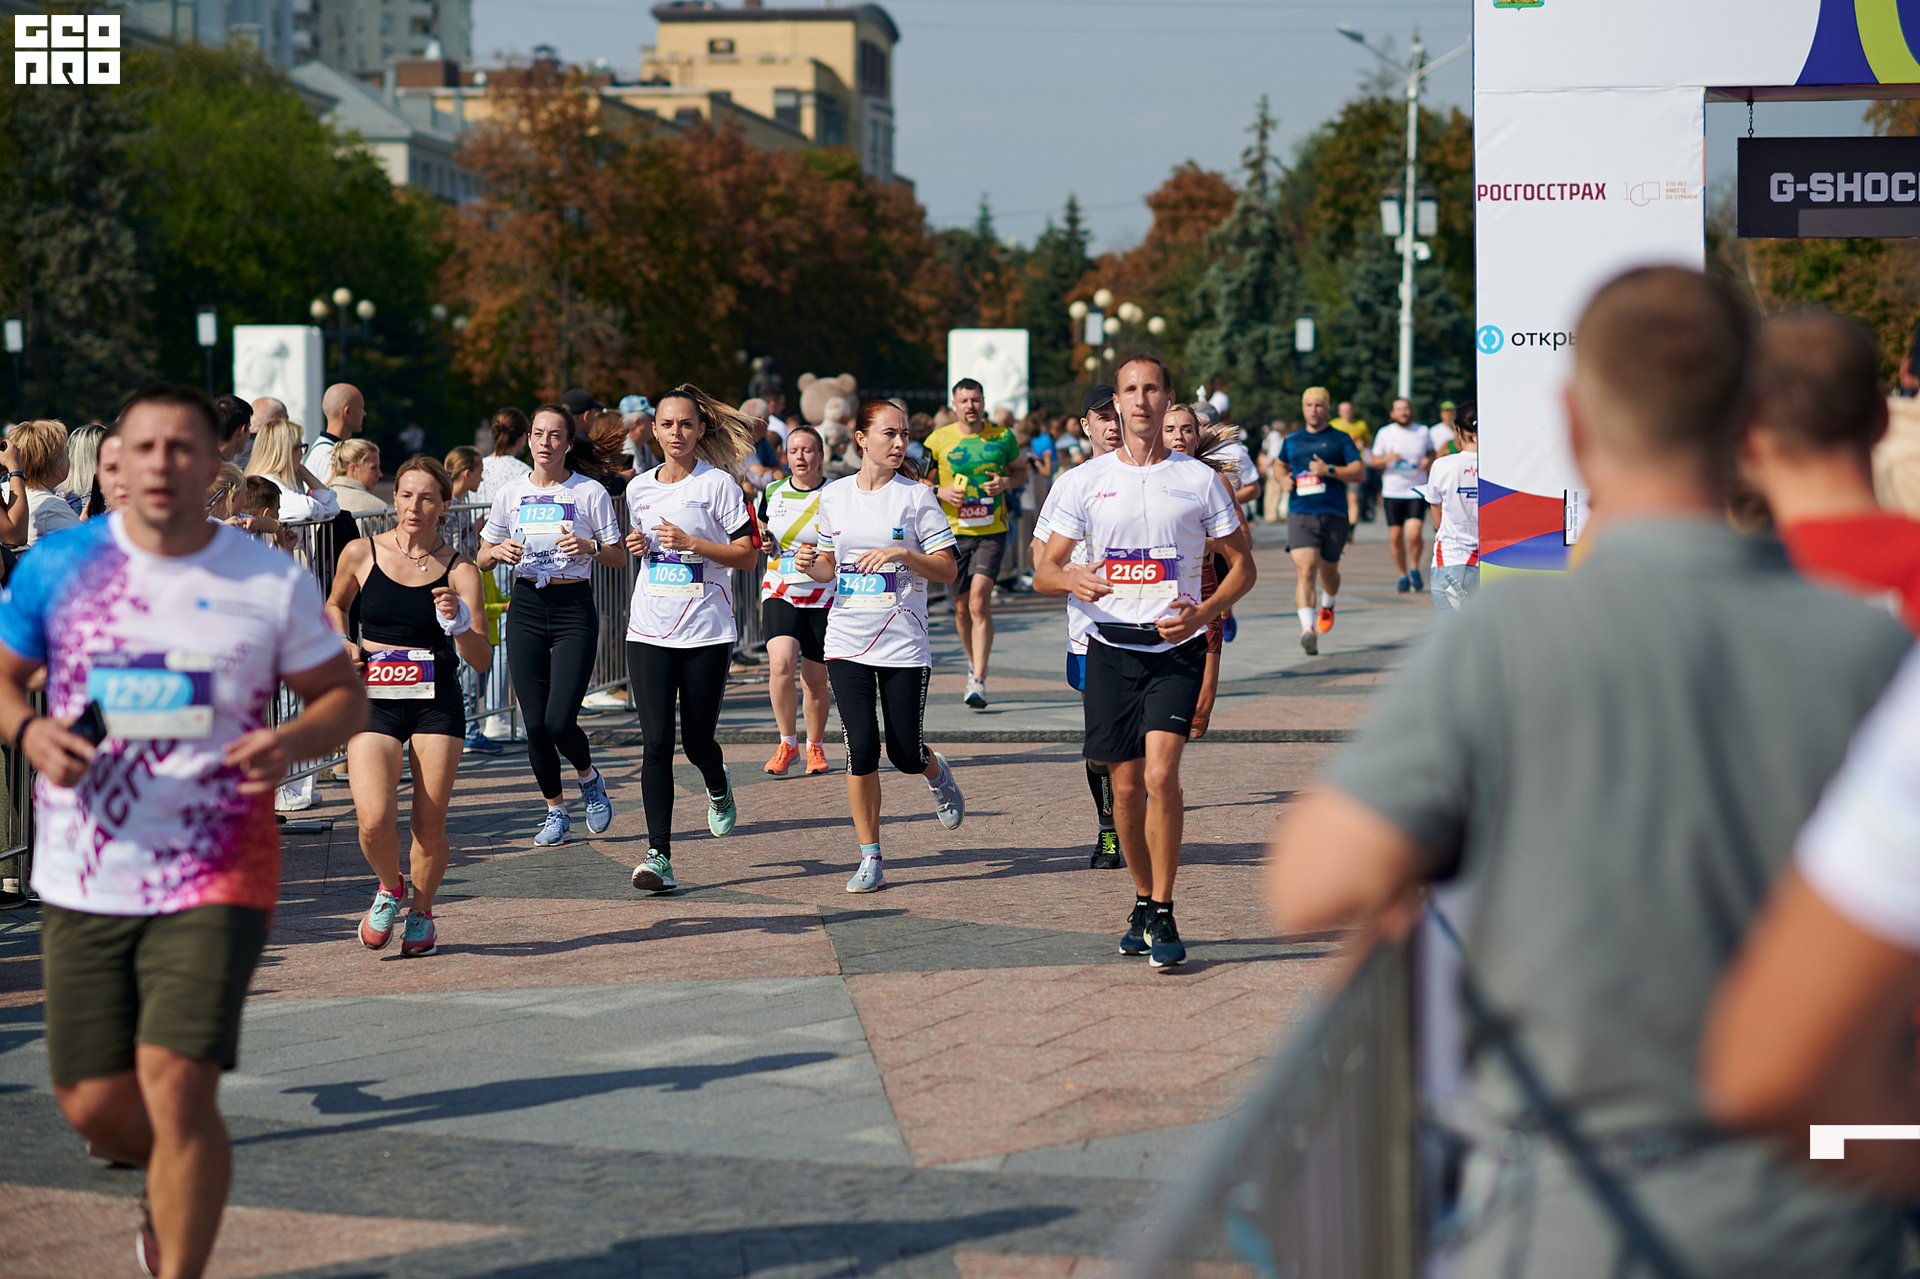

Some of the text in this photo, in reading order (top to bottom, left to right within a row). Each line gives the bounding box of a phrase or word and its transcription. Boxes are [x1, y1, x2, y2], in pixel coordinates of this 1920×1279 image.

[1478, 183, 1606, 201] РОСГОССТРАХ
[1770, 172, 1920, 202] G-SHOC
[525, 507, 556, 521] 1132
[960, 506, 988, 517] 2048
[655, 567, 687, 582] 1065
[1110, 563, 1157, 581] 2166
[844, 577, 877, 592] 1412
[367, 665, 419, 682] 2092
[102, 675, 182, 709] 1297
